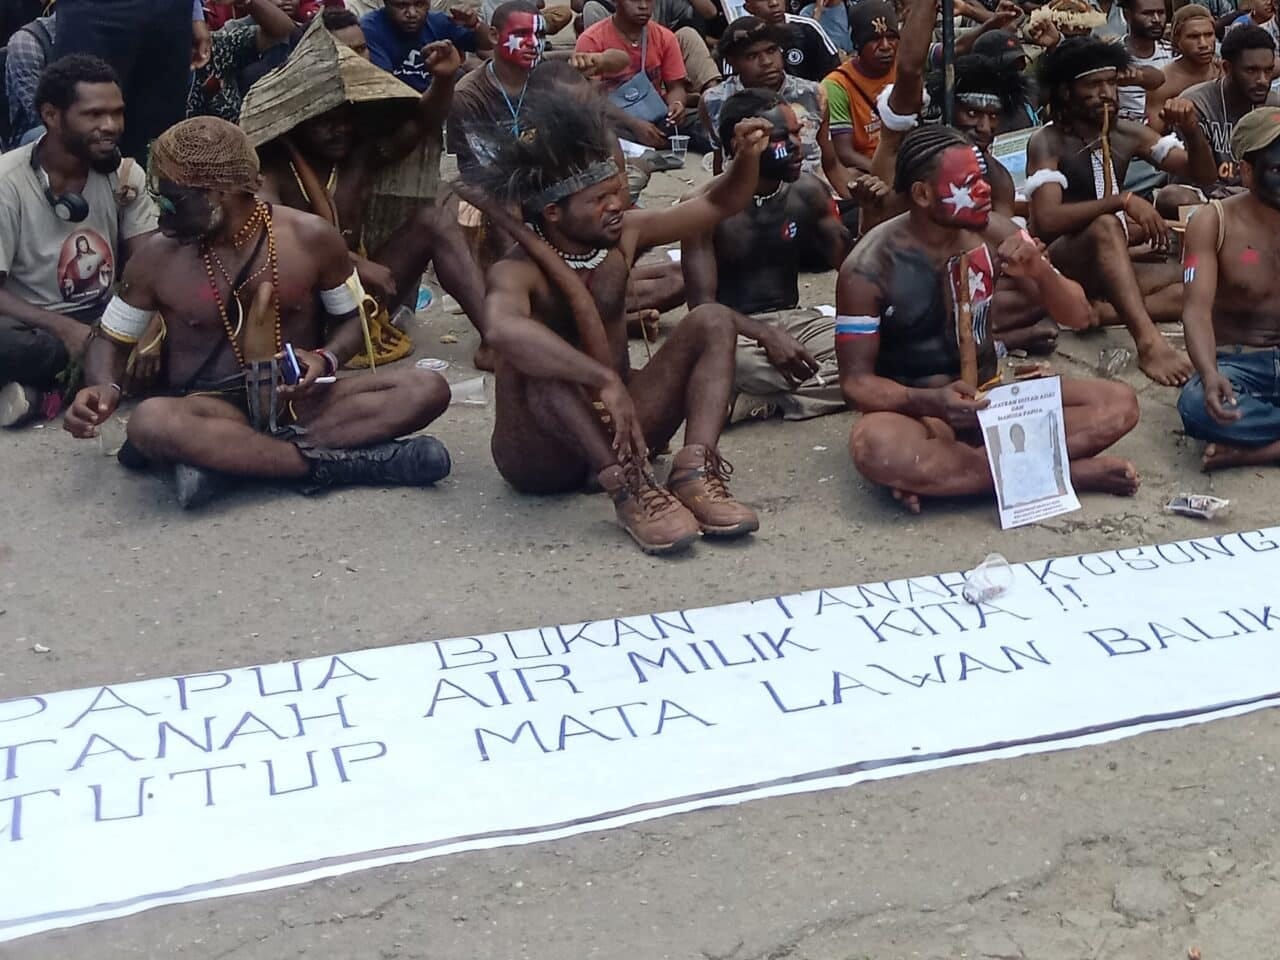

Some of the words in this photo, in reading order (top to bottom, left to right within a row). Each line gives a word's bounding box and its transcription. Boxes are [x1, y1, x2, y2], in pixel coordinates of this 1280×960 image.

[432, 610, 696, 671] BUKAN
[1025, 528, 1280, 586] KOSONG
[0, 694, 356, 782] TANAH
[422, 663, 584, 719] AIR
[626, 626, 821, 685] MILIK
[854, 601, 1032, 644] KITA
[0, 740, 388, 842] TUTUP
[473, 698, 718, 762] MATA
[760, 639, 1052, 714] LAWAN
